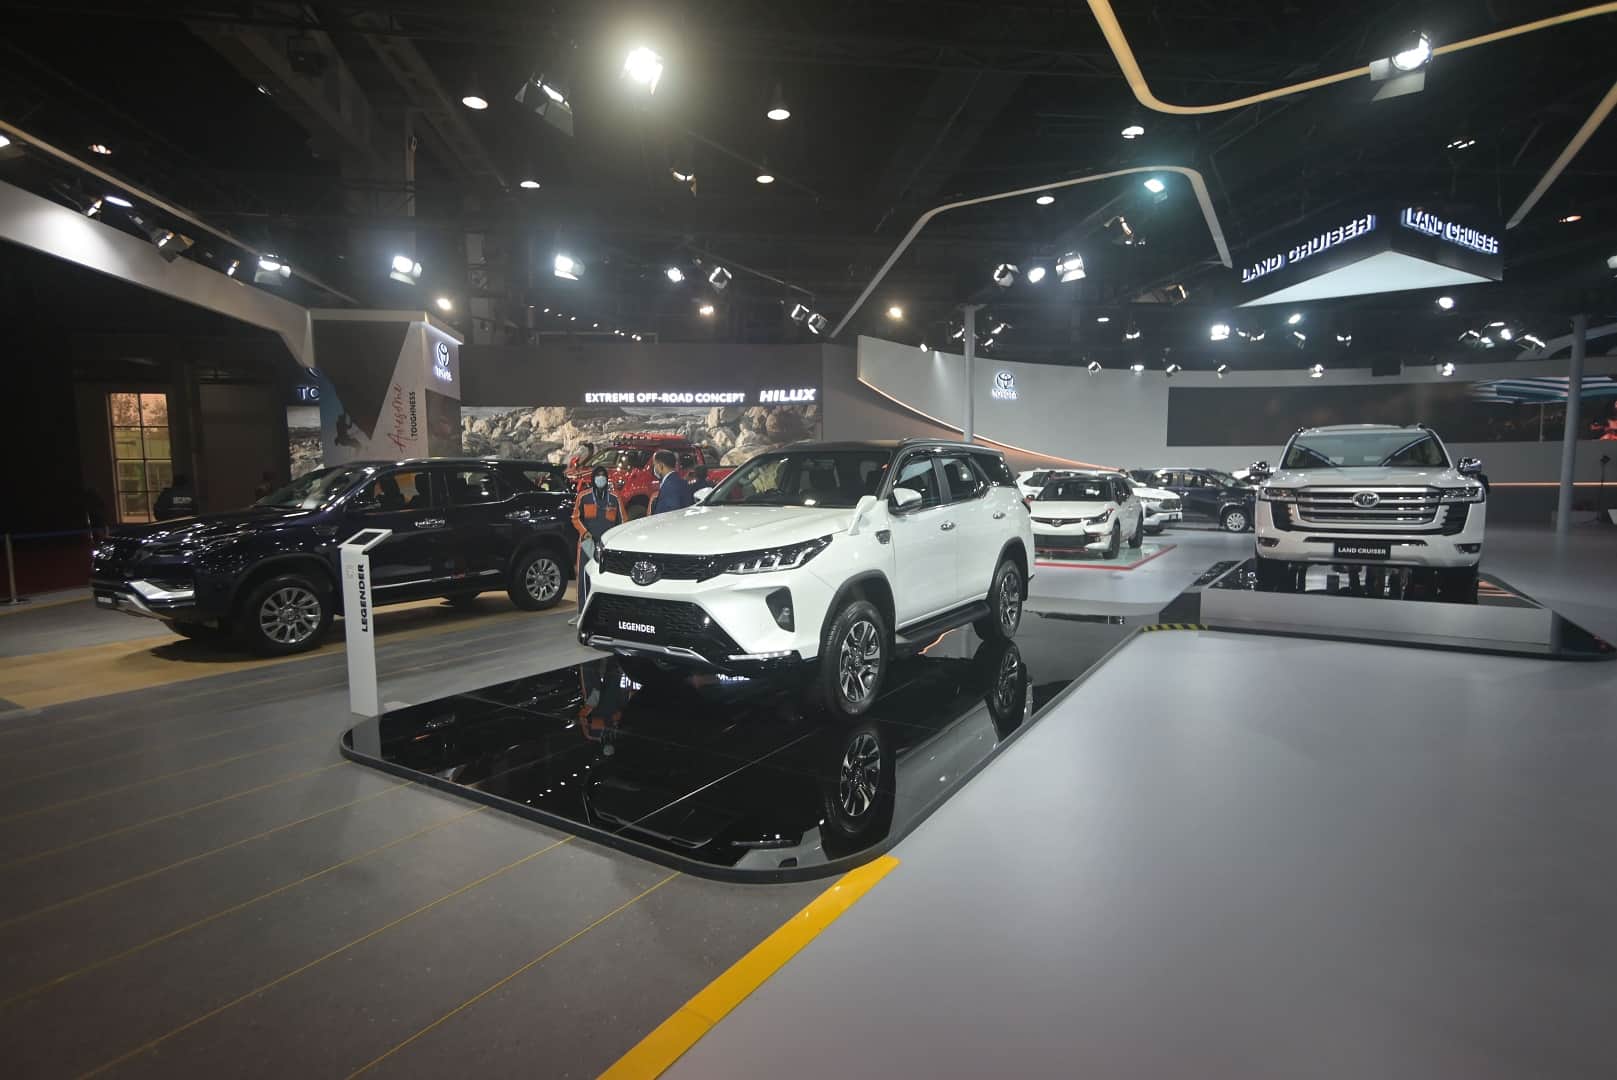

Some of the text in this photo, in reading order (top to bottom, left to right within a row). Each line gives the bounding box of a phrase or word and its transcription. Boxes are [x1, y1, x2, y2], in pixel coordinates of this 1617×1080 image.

[1241, 213, 1376, 283] LAND CRUISER
[1404, 207, 1499, 254] LAND CRUISER
[409, 391, 417, 437] TOUGHNESS
[585, 392, 745, 403] EXTREME OFF-ROAD CONCEPT
[759, 388, 817, 403] HILUX
[357, 564, 369, 632] LEGENDER
[618, 620, 656, 634] LEGENDER
